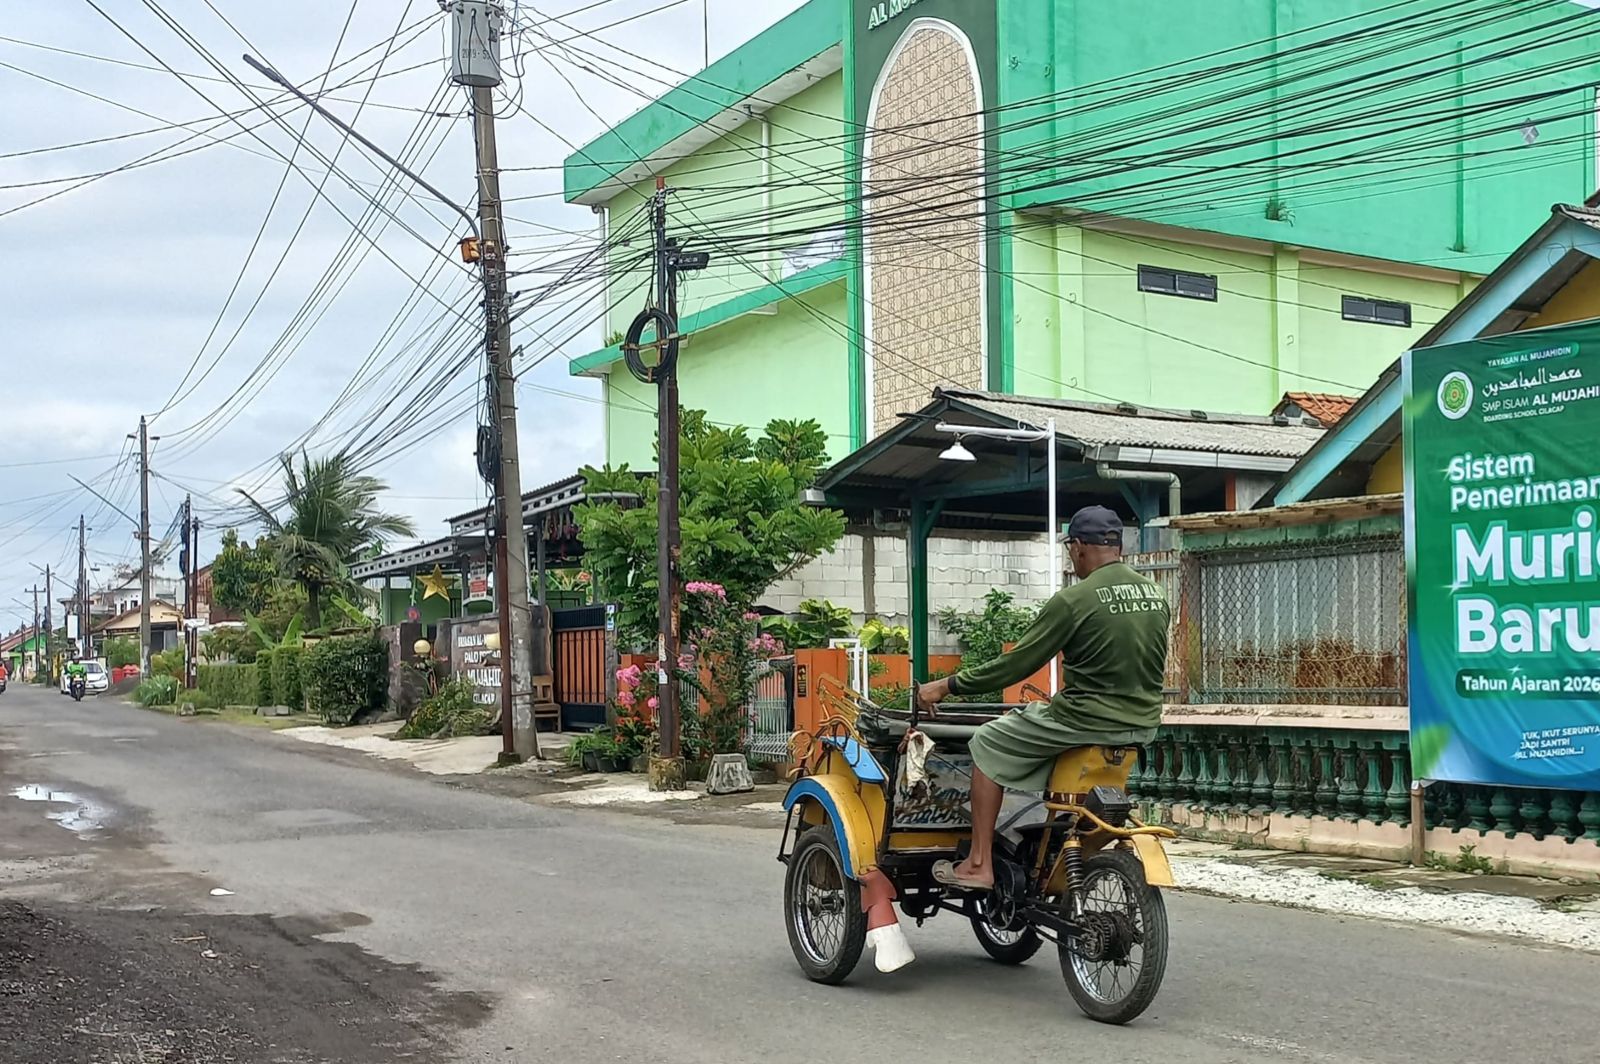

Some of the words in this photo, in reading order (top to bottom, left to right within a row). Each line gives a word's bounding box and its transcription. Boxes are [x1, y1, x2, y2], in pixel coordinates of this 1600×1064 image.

[868, 2, 888, 30] AL
[1487, 355, 1519, 367] YAYASAN
[1520, 354, 1529, 362] AL
[1530, 346, 1572, 360] MUJAHIDIN
[1482, 401, 1501, 413] SMP
[1502, 397, 1530, 410] ISLAM
[1532, 394, 1549, 406] AL
[1483, 411, 1514, 423] BOARDING
[1514, 408, 1538, 419] SCHOOL
[1451, 452, 1535, 481] Sistem
[1455, 510, 1600, 582] Muri
[1096, 587, 1113, 603] UD
[1111, 584, 1144, 600] PUTRA
[1109, 601, 1164, 614] CILACAP
[1457, 598, 1600, 653] Baru
[1461, 675, 1508, 692] Tahun
[1511, 675, 1560, 694] Ajaran
[1563, 675, 1600, 693] 2026
[1541, 729, 1561, 738] IKUT
[1562, 725, 1600, 736] SERUNYA
[1520, 741, 1540, 750] JADI
[1540, 737, 1571, 748] SANTRI
